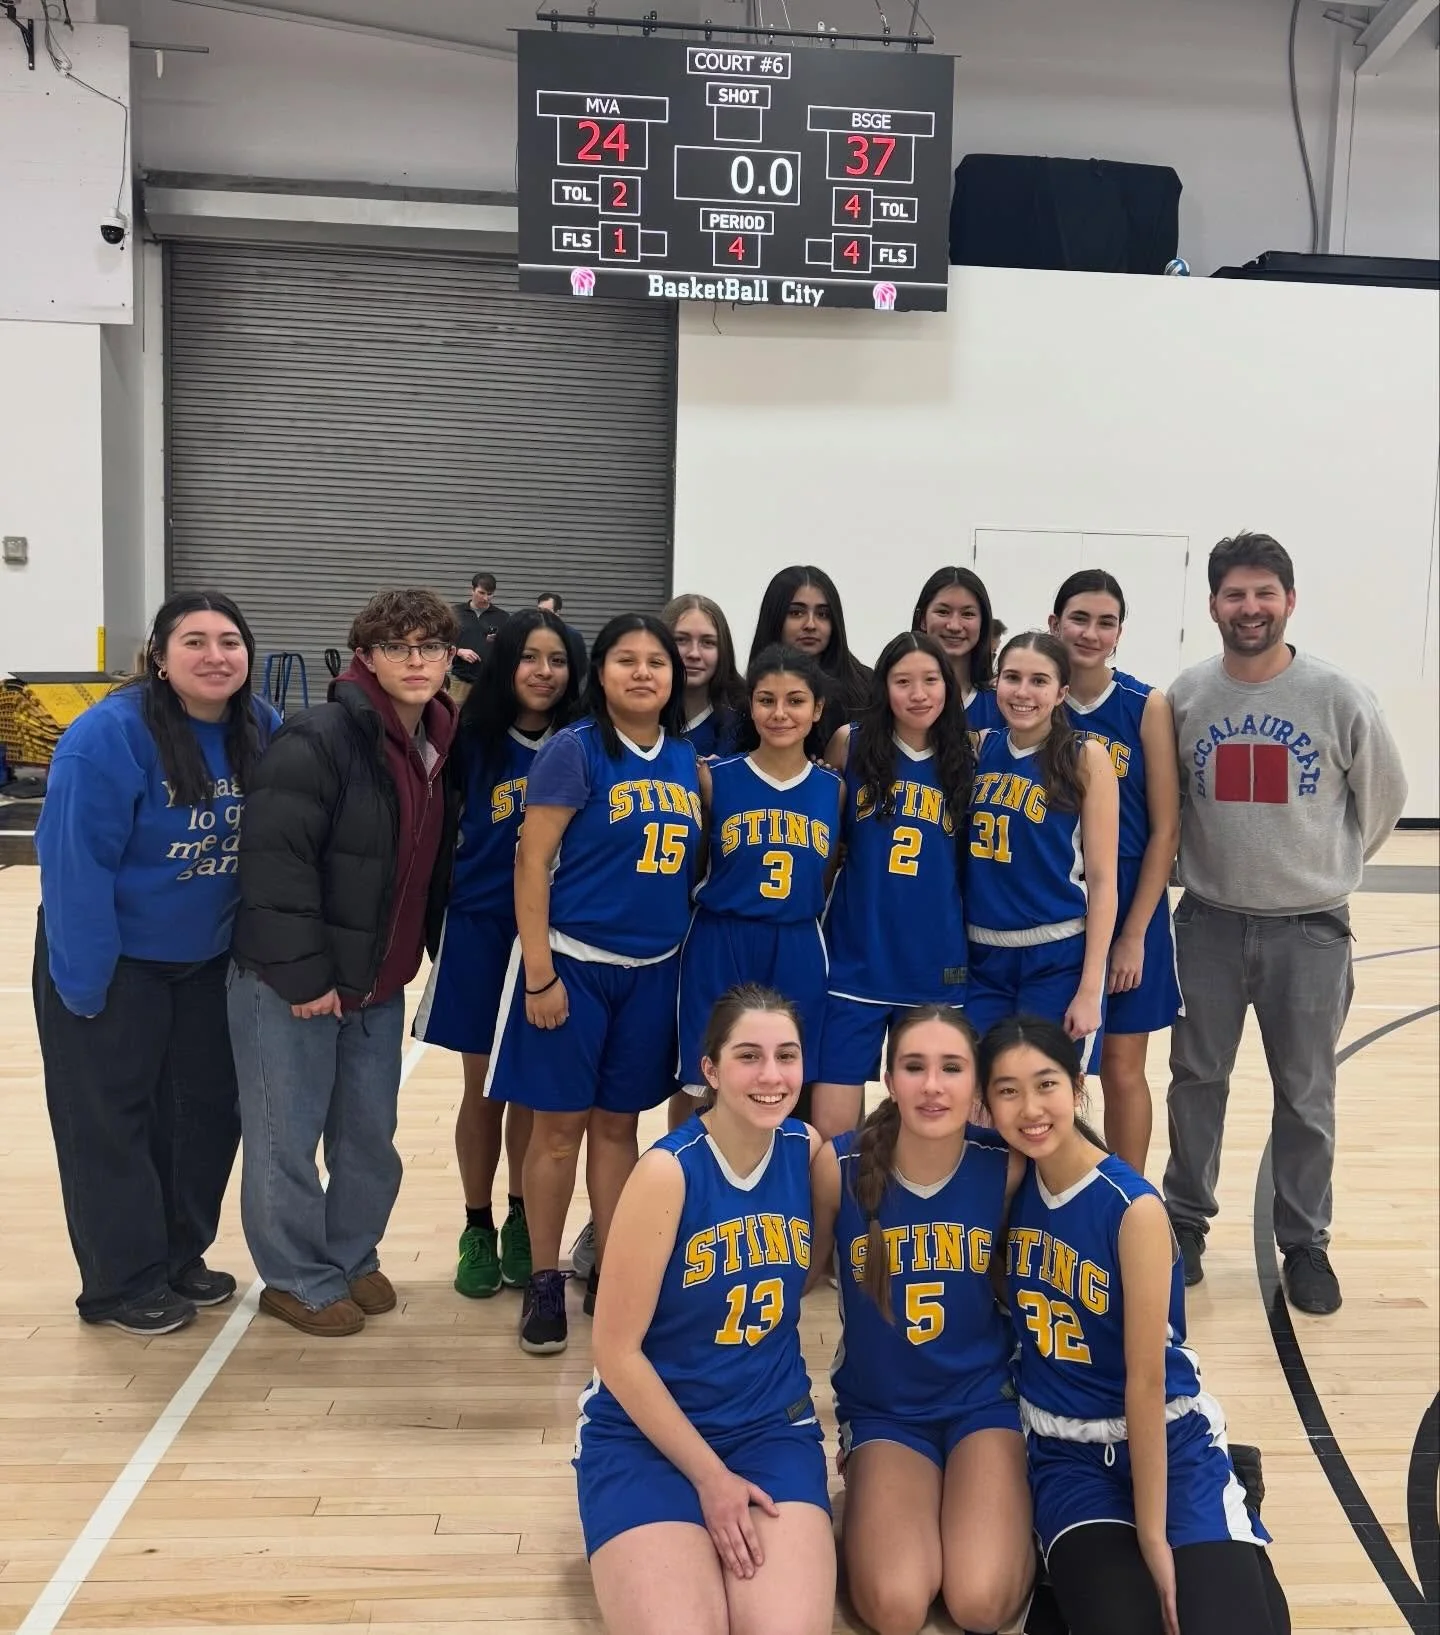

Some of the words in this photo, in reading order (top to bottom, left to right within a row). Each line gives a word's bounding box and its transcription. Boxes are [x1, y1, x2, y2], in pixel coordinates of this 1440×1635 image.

[694, 53, 755, 73] COURT
[760, 54, 784, 74] #6
[586, 97, 621, 114] MVA
[718, 87, 760, 104] SHOT
[851, 113, 892, 130] BSGE
[577, 120, 630, 162] 24
[846, 135, 896, 176] 37
[730, 155, 793, 197] 0.0
[562, 186, 592, 202] TOL
[612, 181, 627, 207] 2
[844, 194, 861, 219] 4
[709, 214, 765, 231] PERIOD
[880, 202, 909, 218] TOL
[562, 232, 592, 248] FLS
[613, 228, 626, 253] 1
[728, 237, 745, 261] 4
[844, 240, 860, 265] 4
[879, 248, 907, 264] FLS
[648, 274, 769, 302] BasketBall
[781, 281, 825, 307] City
[969, 772, 1049, 824] TING
[187, 805, 216, 830] lo
[721, 808, 830, 858] STING
[970, 811, 1013, 864] 31
[636, 822, 689, 875] 15
[888, 825, 923, 877] 2
[759, 850, 794, 900] 3
[682, 1213, 811, 1289] STING
[714, 1277, 785, 1347] 13
[905, 1281, 945, 1346] 5
[1016, 1288, 1093, 1365] 32
